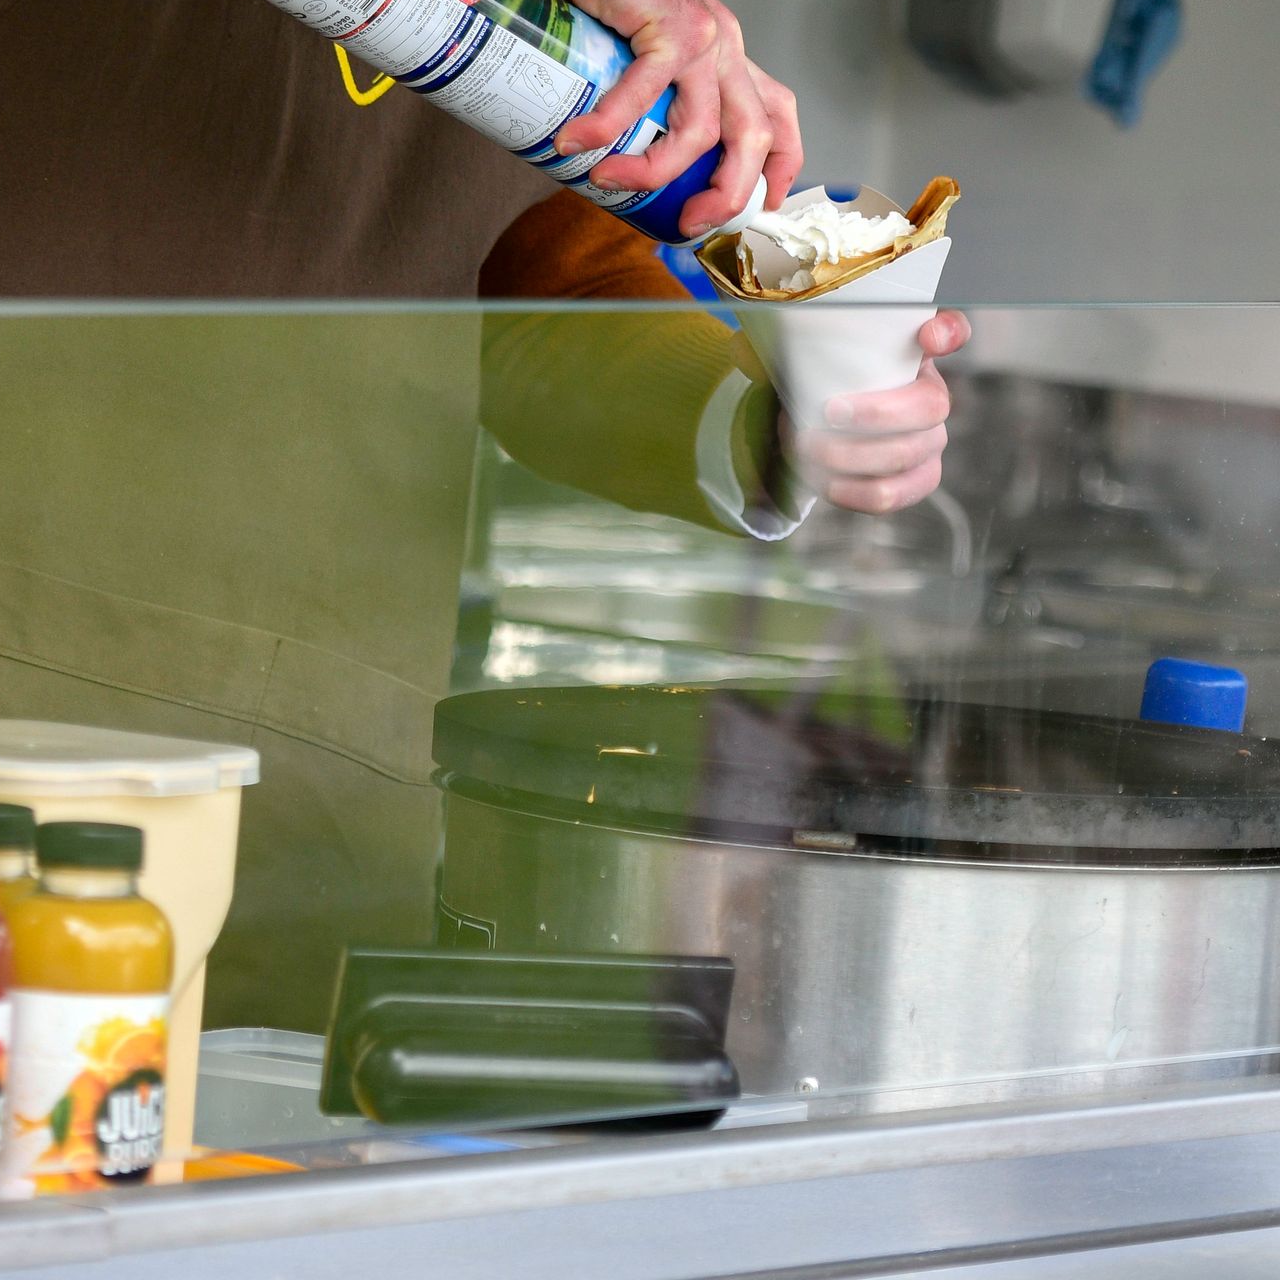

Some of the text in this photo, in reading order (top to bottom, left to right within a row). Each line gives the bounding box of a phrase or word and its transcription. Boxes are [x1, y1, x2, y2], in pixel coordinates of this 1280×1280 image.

[405, 6, 419, 23] sugars
[430, 0, 441, 15] which
[444, 2, 458, 19] Energy
[332, 14, 350, 27] 0845
[413, 15, 431, 36] saturates
[425, 9, 472, 68] NUTRITION INFORMATION
[443, 21, 489, 78] STORAGE INSTRUCTIONS
[501, 38, 518, 61] Warning:
